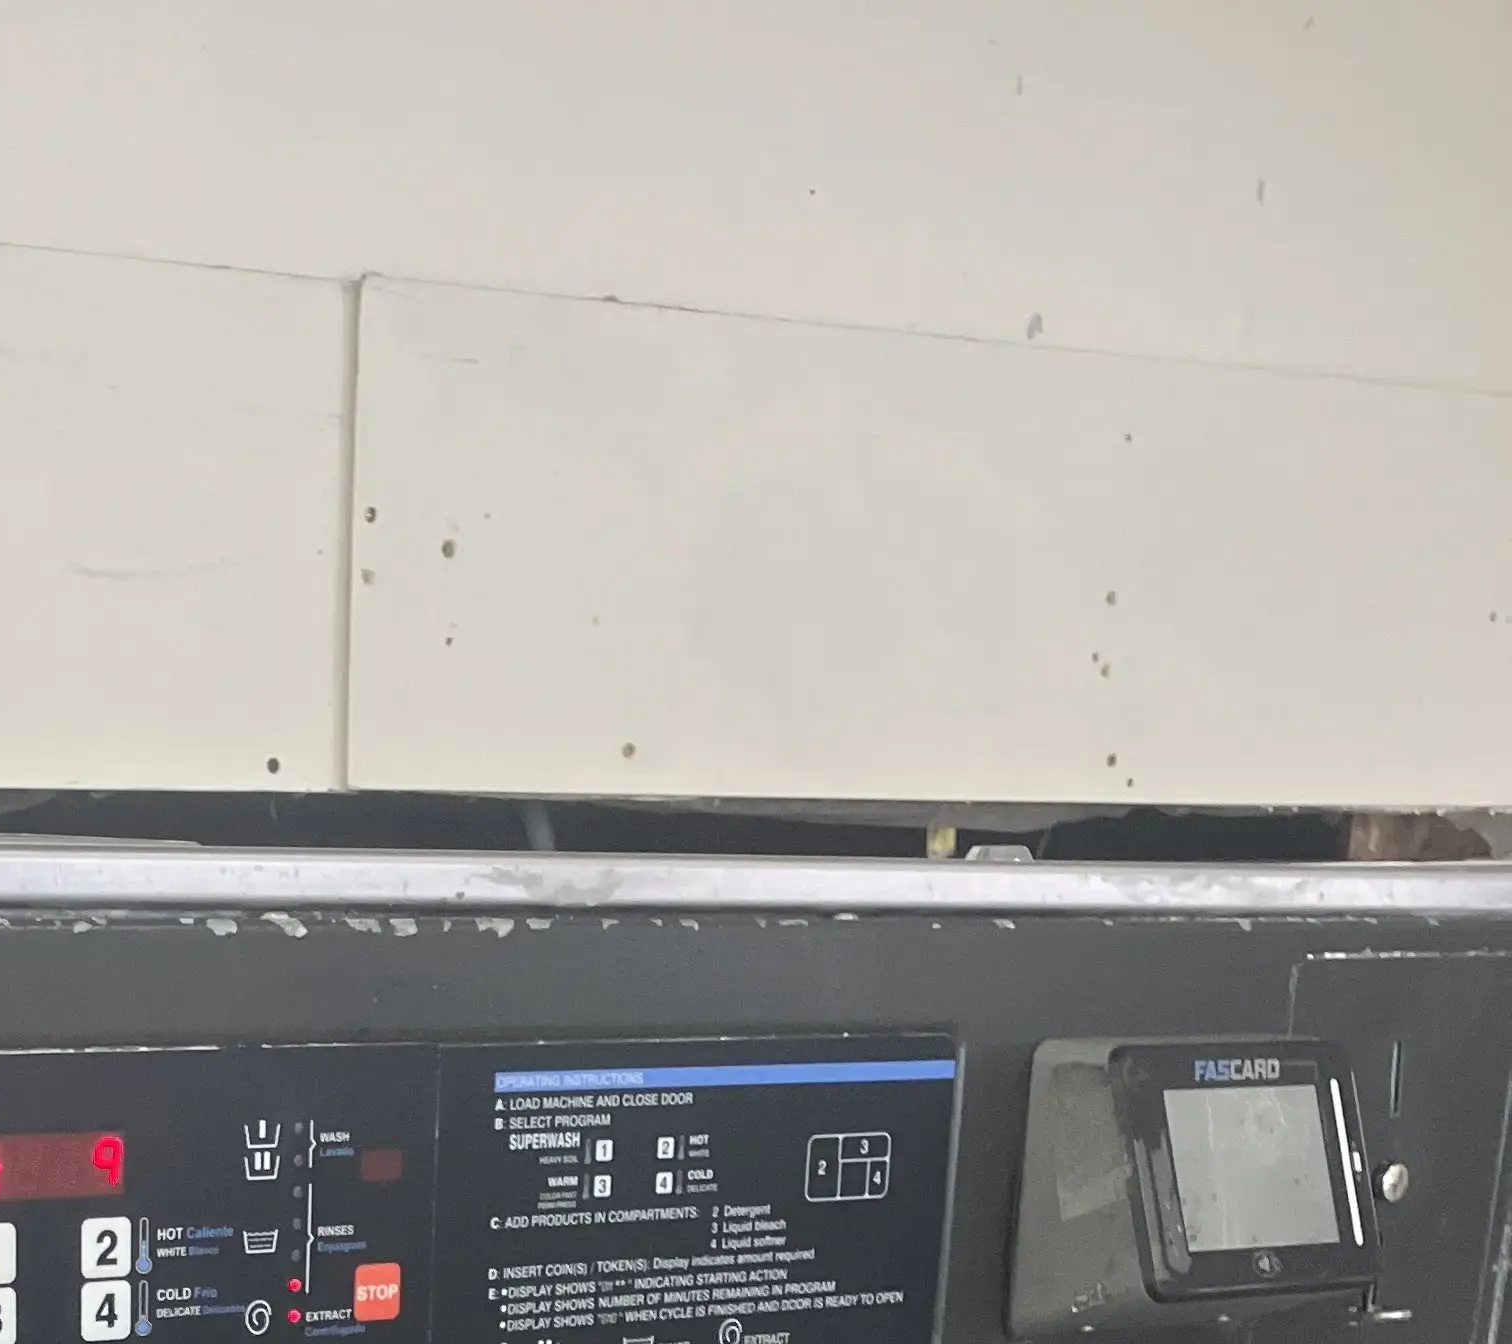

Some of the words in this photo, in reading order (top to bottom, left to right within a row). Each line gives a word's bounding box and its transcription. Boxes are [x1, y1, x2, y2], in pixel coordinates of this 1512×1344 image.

[1195, 1058, 1280, 1082] FASCARD
[497, 1075, 560, 1089] OPERATING
[564, 1072, 644, 1087] INSTRUCTIONS
[509, 1098, 539, 1110] LOAD
[543, 1096, 593, 1109] MACHINE
[596, 1095, 620, 1107] AND
[621, 1094, 658, 1106] CLOSE
[661, 1092, 693, 1105] DOOR
[509, 1116, 551, 1129] SELECT
[555, 1114, 611, 1127] PROGRAM
[320, 1132, 350, 1143] WASH
[509, 1132, 580, 1150] SUPERWASH
[602, 1144, 607, 1158] 1
[662, 1142, 670, 1155] 2
[860, 1138, 869, 1154] 3
[818, 1160, 827, 1175] 2
[548, 1176, 578, 1187] WARM
[598, 1180, 607, 1193] 3
[659, 1176, 667, 1189] 4
[688, 1169, 714, 1180] COLD
[873, 1171, 881, 1185] 4
[505, 1216, 528, 1229] ADD
[532, 1212, 592, 1227] PRODUCTS
[595, 1212, 606, 1223] IN
[711, 1222, 718, 1234] 3
[317, 1225, 354, 1237] RINSES
[96, 1229, 118, 1266] 2
[157, 1228, 183, 1240] HOT
[187, 1226, 234, 1239] Caliente
[710, 1239, 716, 1249] 4
[157, 1247, 187, 1258] WHITE
[504, 1265, 542, 1279] INSERT
[356, 1284, 399, 1300] STOP
[508, 1285, 552, 1298] DISPLAY
[555, 1282, 596, 1296] SHOWS
[634, 1274, 694, 1289] INDICATING
[697, 1271, 747, 1285] STARTING
[507, 1301, 551, 1315] DISPLAY
[554, 1298, 594, 1311] SHOWS
[598, 1294, 644, 1308] NUMBER
[785, 1281, 836, 1294] PROGRAM
[95, 1293, 118, 1328] 4
[157, 1288, 191, 1301] COLD
[156, 1305, 202, 1318] DELICATE
[306, 1309, 352, 1322] EXTRACT
[507, 1318, 551, 1332] DISPLAY
[553, 1314, 594, 1328] SHOWS
[695, 1305, 706, 1317] IS
